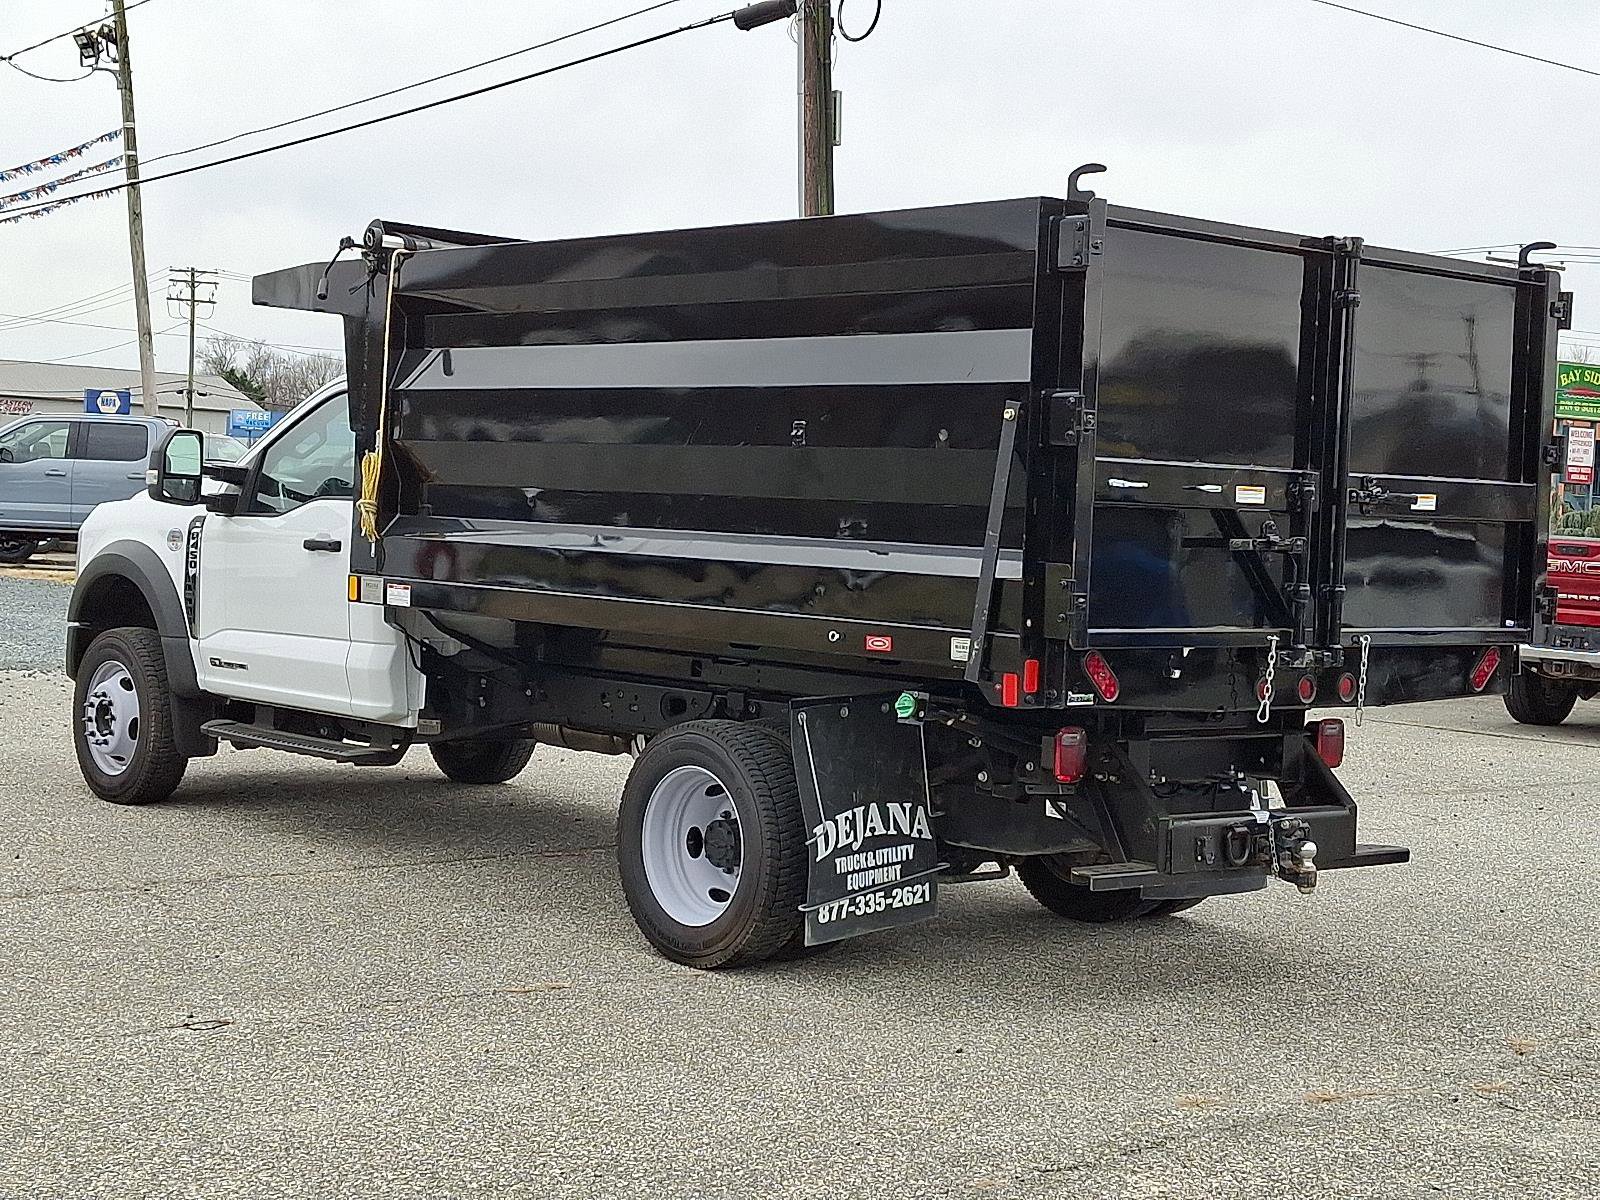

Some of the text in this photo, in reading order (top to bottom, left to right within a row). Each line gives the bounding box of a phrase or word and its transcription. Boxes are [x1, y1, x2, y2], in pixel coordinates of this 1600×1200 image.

[1560, 369, 1582, 387] BAY
[246, 412, 270, 420] FREE
[813, 802, 933, 862] DEJANA
[846, 864, 902, 891] EQUIPMENT
[818, 882, 931, 924] 877-335-2621
